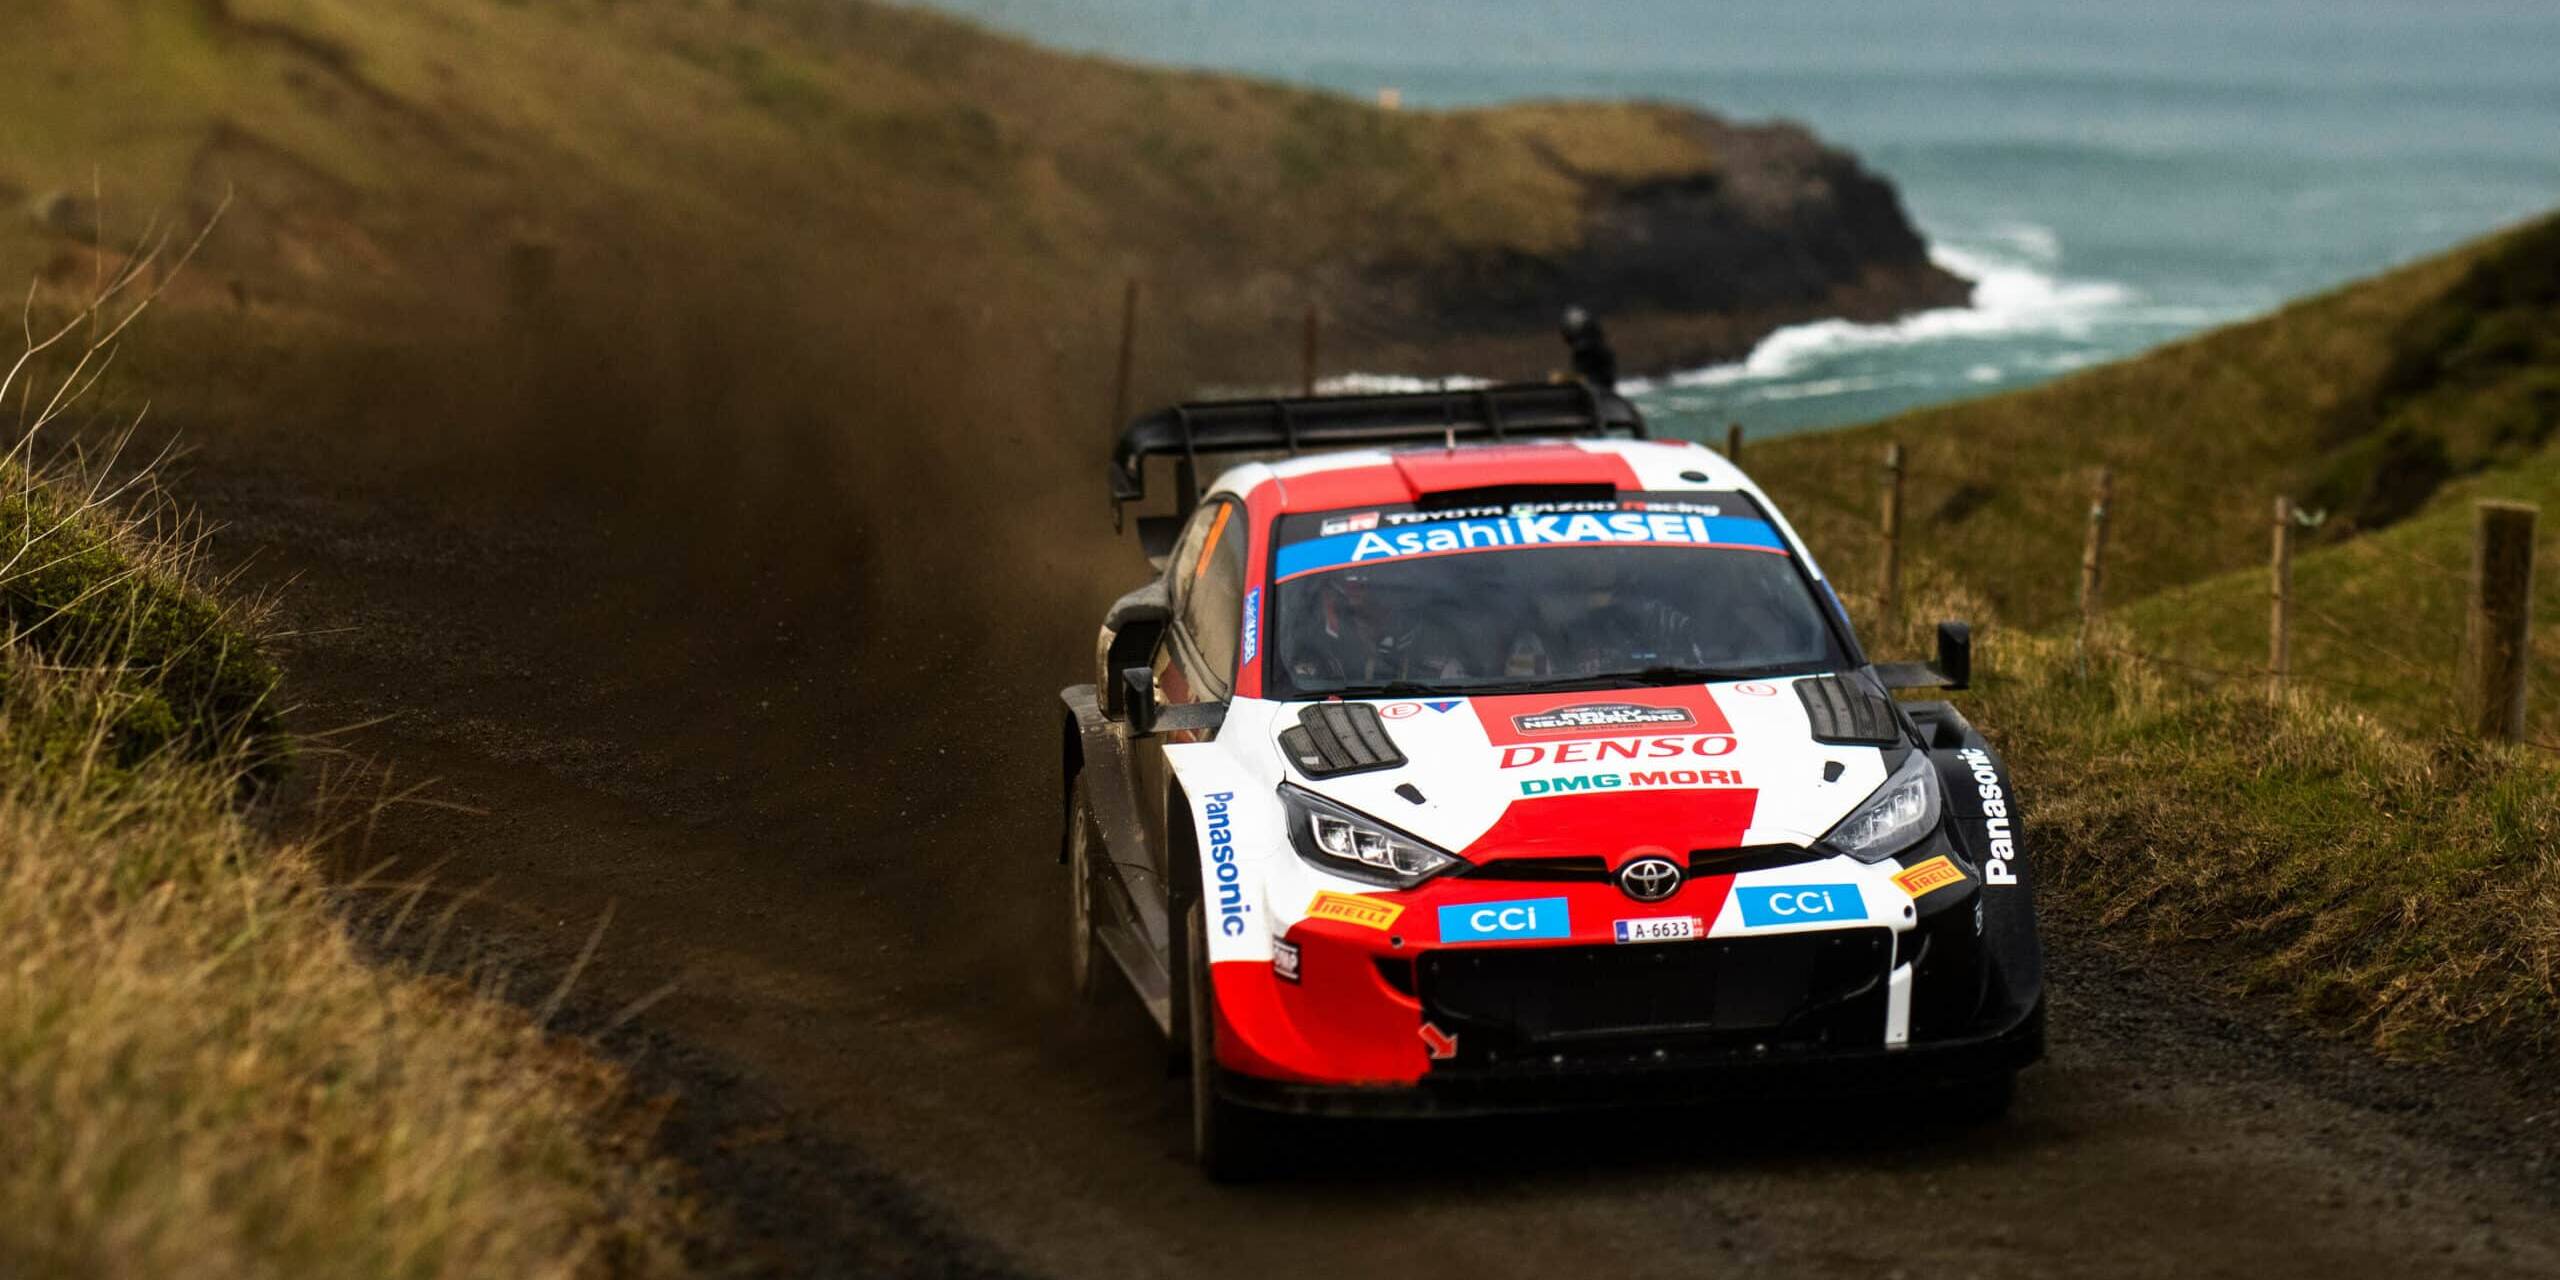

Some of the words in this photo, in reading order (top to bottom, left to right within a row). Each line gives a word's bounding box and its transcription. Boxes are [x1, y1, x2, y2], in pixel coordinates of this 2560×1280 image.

[1320, 512, 1380, 537] GR
[1385, 506, 1504, 525] TOYOTA
[1510, 501, 1617, 517] GAZOO
[1622, 501, 1720, 517] Racing
[1523, 719, 1575, 729] NEW
[1560, 709, 1641, 721] RALLY
[1500, 736, 1738, 769] DENSO
[1520, 774, 1621, 795] DMG
[1630, 770, 1743, 786] MORI
[1957, 748, 2018, 886] Panasonic
[1204, 791, 1251, 937] Panasonic
[1898, 861, 1957, 892] PIRELLI
[1312, 895, 1394, 924] PIRELLI
[1635, 922, 1690, 938] A-6633
